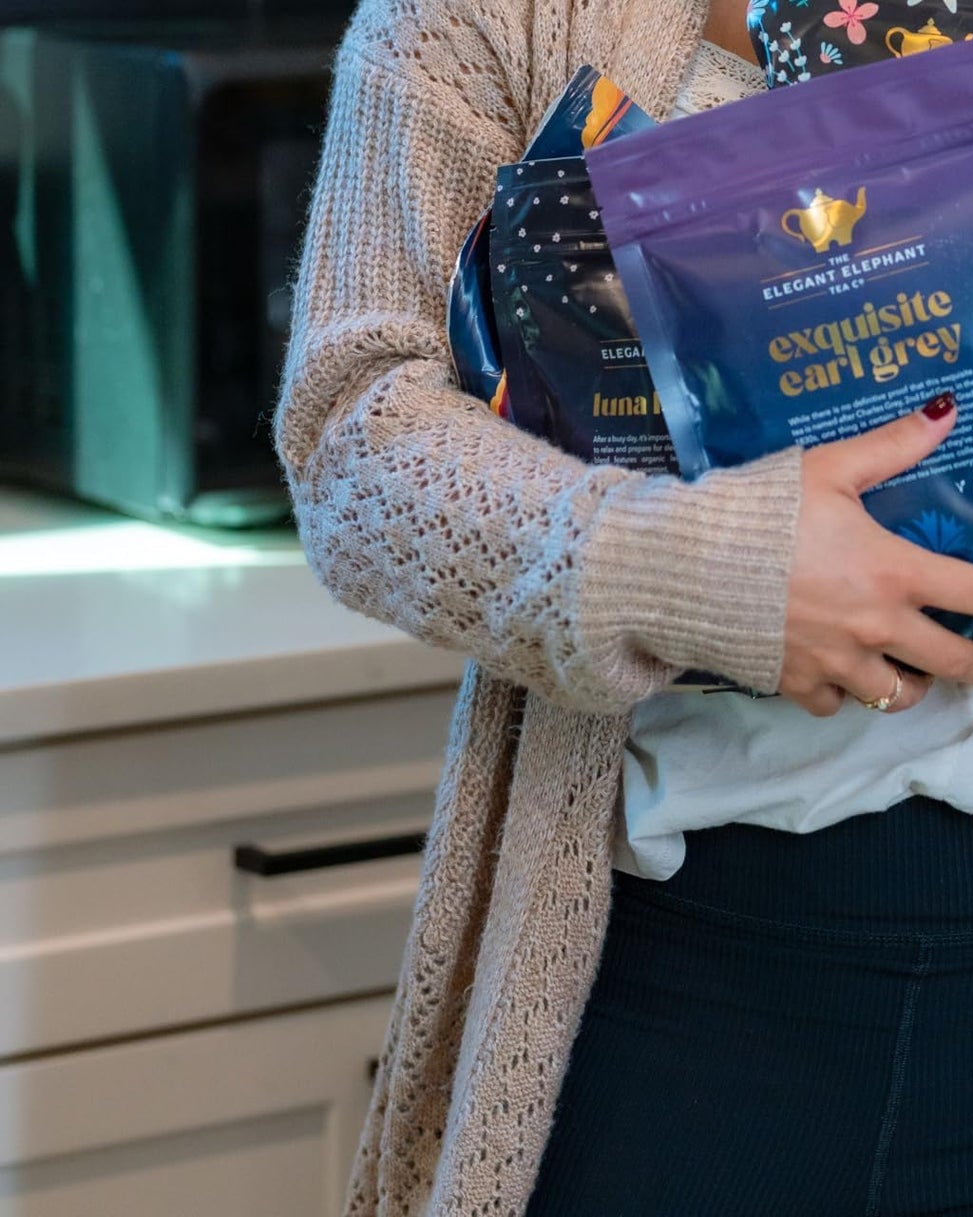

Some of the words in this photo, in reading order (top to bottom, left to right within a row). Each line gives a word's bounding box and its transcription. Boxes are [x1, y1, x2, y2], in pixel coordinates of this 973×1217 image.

[829, 254, 849, 266] THE
[763, 271, 836, 300] ELEGANT
[841, 244, 926, 277] ELEPHANT
[829, 283, 849, 295] TEA
[769, 291, 953, 363] exquisite
[601, 347, 645, 360] ELEGA
[779, 346, 864, 396] earl
[870, 324, 960, 383] grey
[593, 392, 647, 416] luna
[788, 414, 810, 426] While
[812, 409, 830, 418] there
[852, 392, 886, 407] definitive
[888, 386, 908, 398] proof
[910, 382, 924, 391] that
[926, 378, 939, 387] this
[941, 369, 973, 383] exquisite
[791, 428, 803, 436] tea
[812, 417, 837, 430] named
[839, 412, 854, 422] after
[856, 403, 883, 417] Charles
[905, 394, 919, 403] 2nd
[920, 389, 934, 399] Earl
[648, 433, 669, 443] import
[821, 431, 835, 439] one
[838, 422, 858, 436] thing
[949, 424, 972, 436] onder
